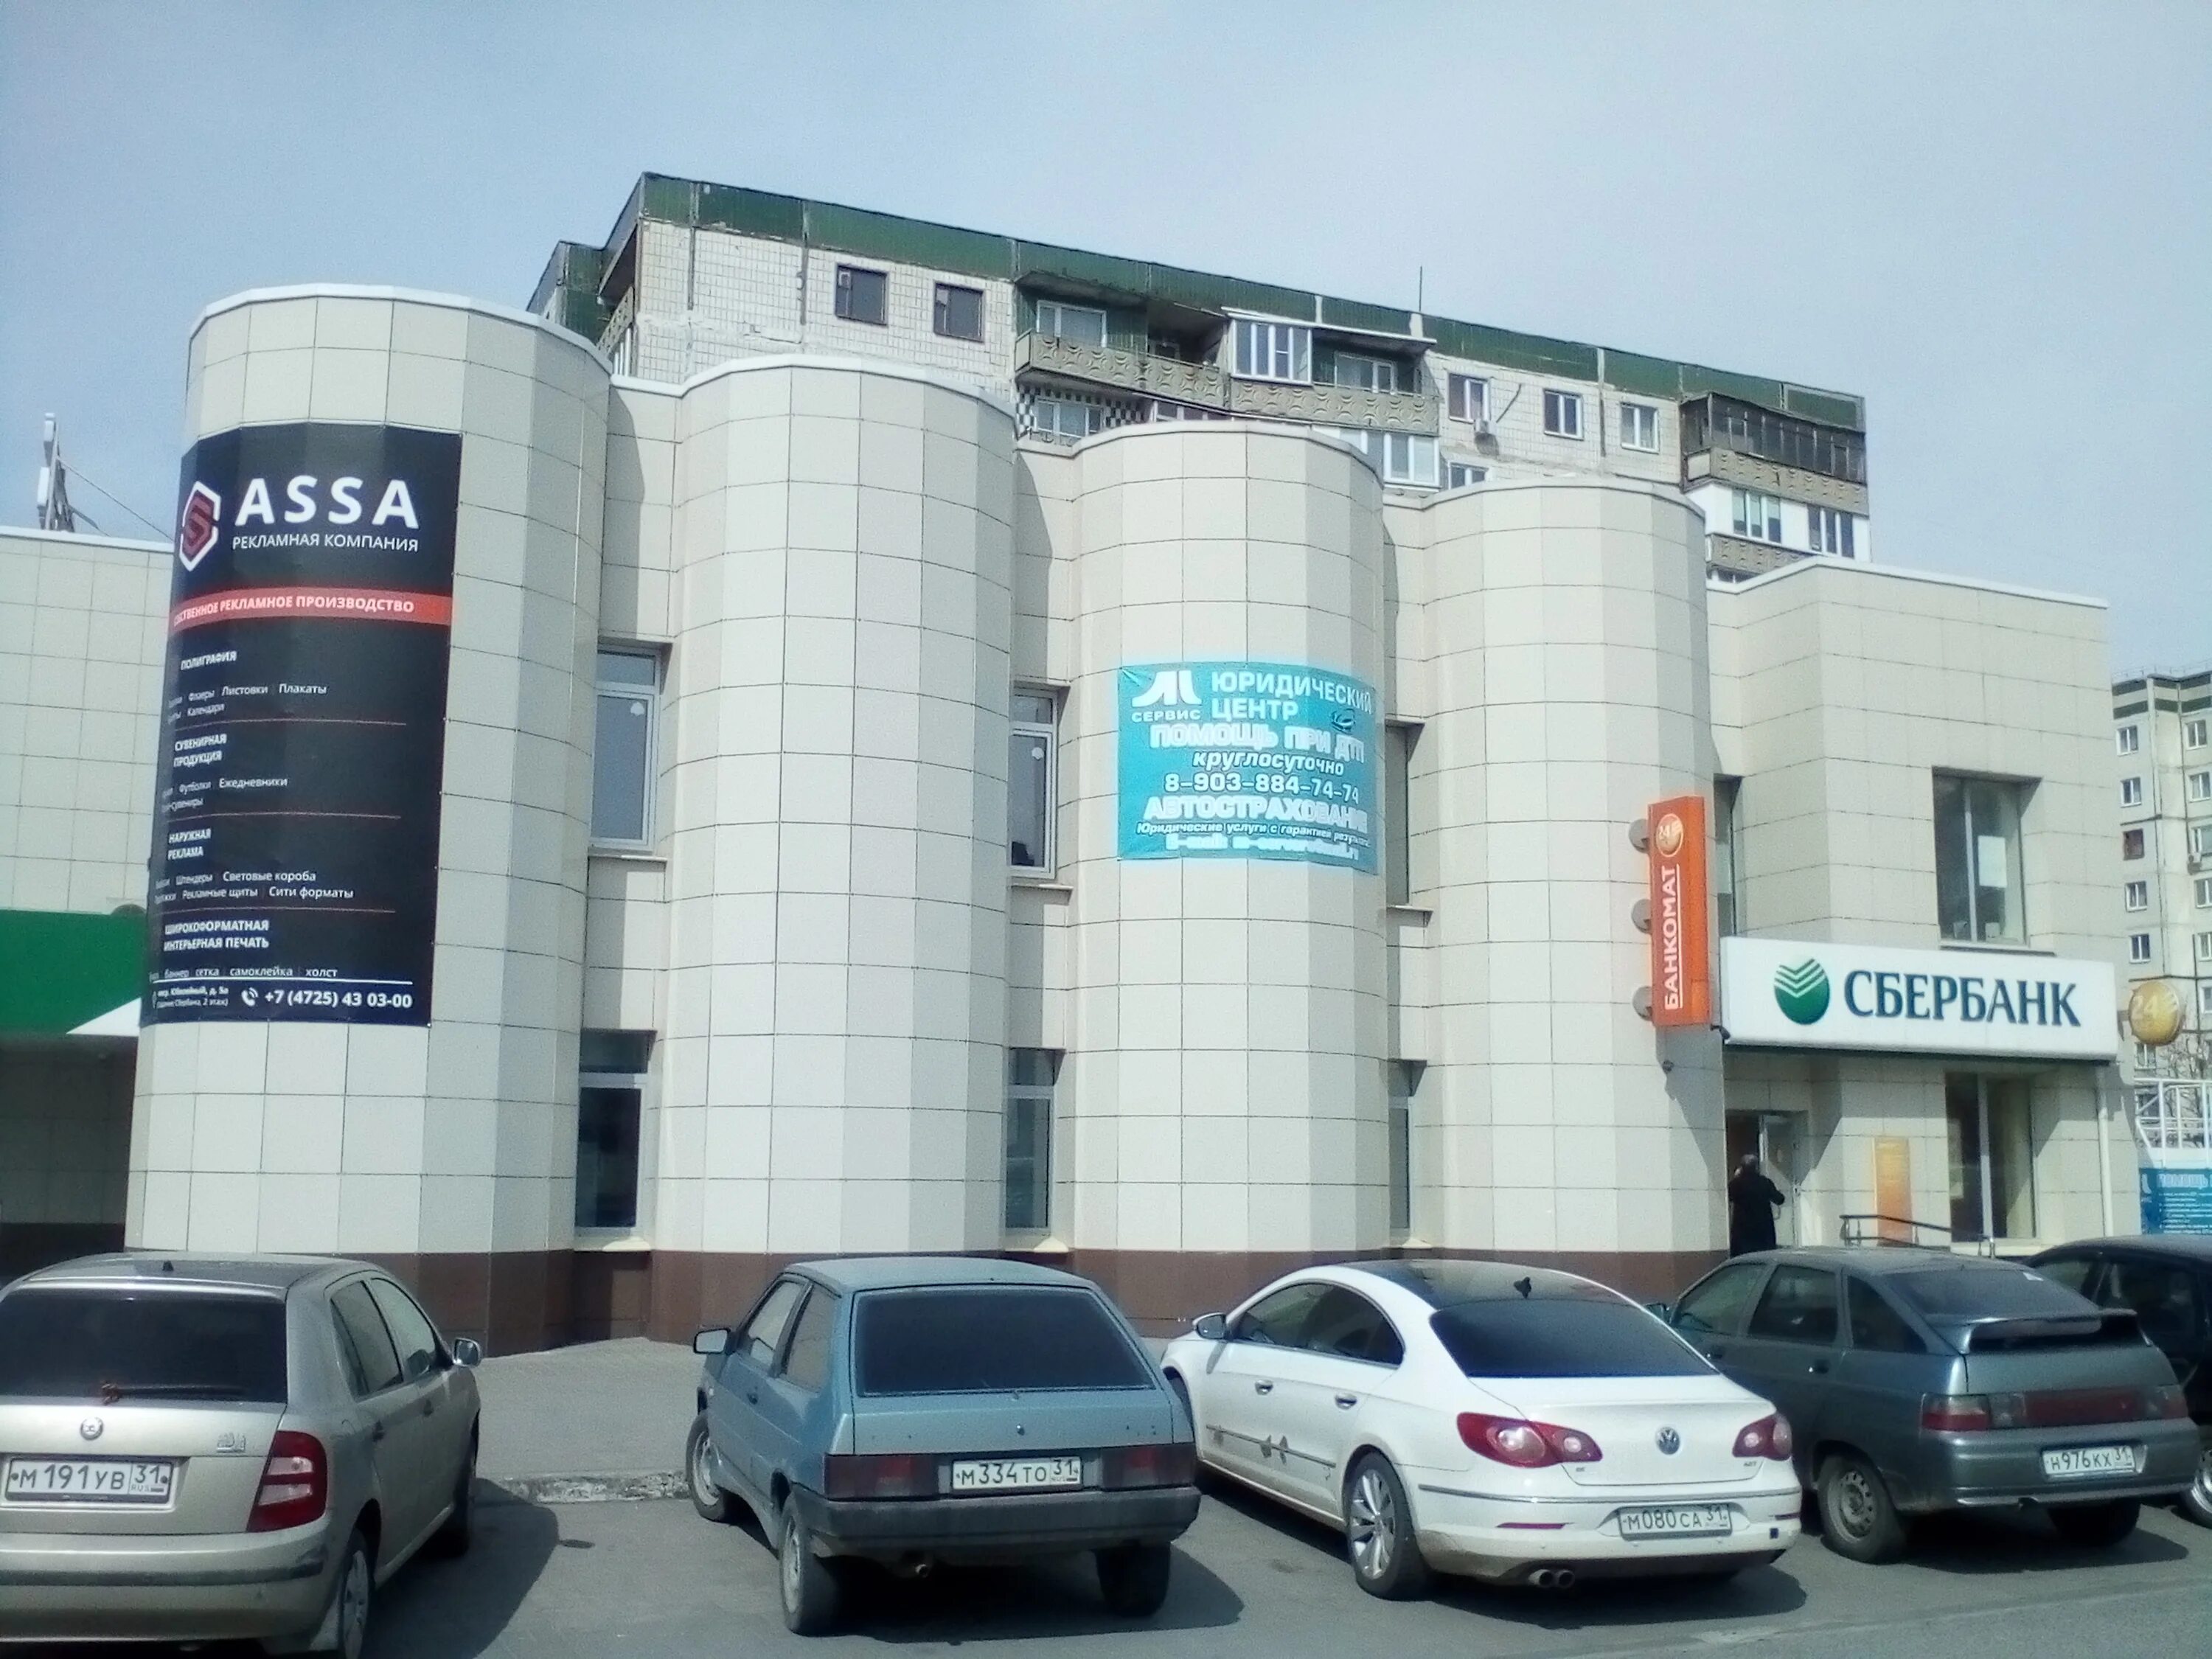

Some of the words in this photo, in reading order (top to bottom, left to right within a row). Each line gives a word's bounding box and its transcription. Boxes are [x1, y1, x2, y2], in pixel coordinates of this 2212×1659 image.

[234, 475, 419, 529] ASSA
[232, 533, 319, 550] РЕКЛАМНАЯ
[324, 534, 419, 552] КОМПАНИЯ
[220, 596, 293, 611] РЕКЛАМНОЕ
[296, 595, 414, 613] ПРОИЗВОДСТВО
[181, 650, 237, 670] ПОЛИГРАФИЯ
[222, 686, 268, 696] Листовки
[279, 684, 327, 694] Плакаты
[1211, 671, 1372, 714] ЮРИДИЧЕСКИЙ
[1131, 709, 1201, 723] СЕРВИС
[1211, 697, 1298, 722] ЦЕНТР
[174, 734, 227, 751] СУВЕНИРНАЯ
[1150, 723, 1279, 751] ПОМОЩЬ
[1284, 725, 1332, 754] ПРИ
[1335, 734, 1364, 764] ДТП
[173, 751, 222, 768] ПРОДУКЦИЯ
[1192, 751, 1344, 776] круглосуточно
[219, 778, 288, 789] Ежедневники
[1164, 773, 1360, 804] 8-903-884-74-74
[168, 828, 212, 844] НАРУЖНАЯ
[1136, 821, 1222, 836] Юридические
[1226, 823, 1267, 836] услуги
[1269, 825, 1277, 834] с
[167, 846, 204, 860] РЕКЛАМА
[223, 872, 273, 882] Световые
[275, 871, 316, 883] короба
[229, 888, 258, 899] щиты
[269, 886, 296, 897] Сити
[299, 886, 353, 900] форматы
[164, 920, 269, 935] ШИРОКОФОРМАТНАЯ
[164, 938, 223, 951] ИНТЕРЬЕРНАЯ
[225, 937, 269, 949] ПЕЧАТЬ
[1661, 866, 1679, 1011] БАНКОМАТ
[195, 968, 220, 976] сетка
[229, 965, 293, 977] самоклейка
[305, 968, 338, 977] холст
[265, 990, 285, 1004] +7
[287, 990, 338, 1008] (4725)
[341, 992, 362, 1006] 43
[366, 993, 413, 1008] 03-00
[1843, 969, 2081, 1028] СБЕРБАНК
[135, 1465, 161, 1484] 31
[1053, 1458, 1073, 1475] 31
